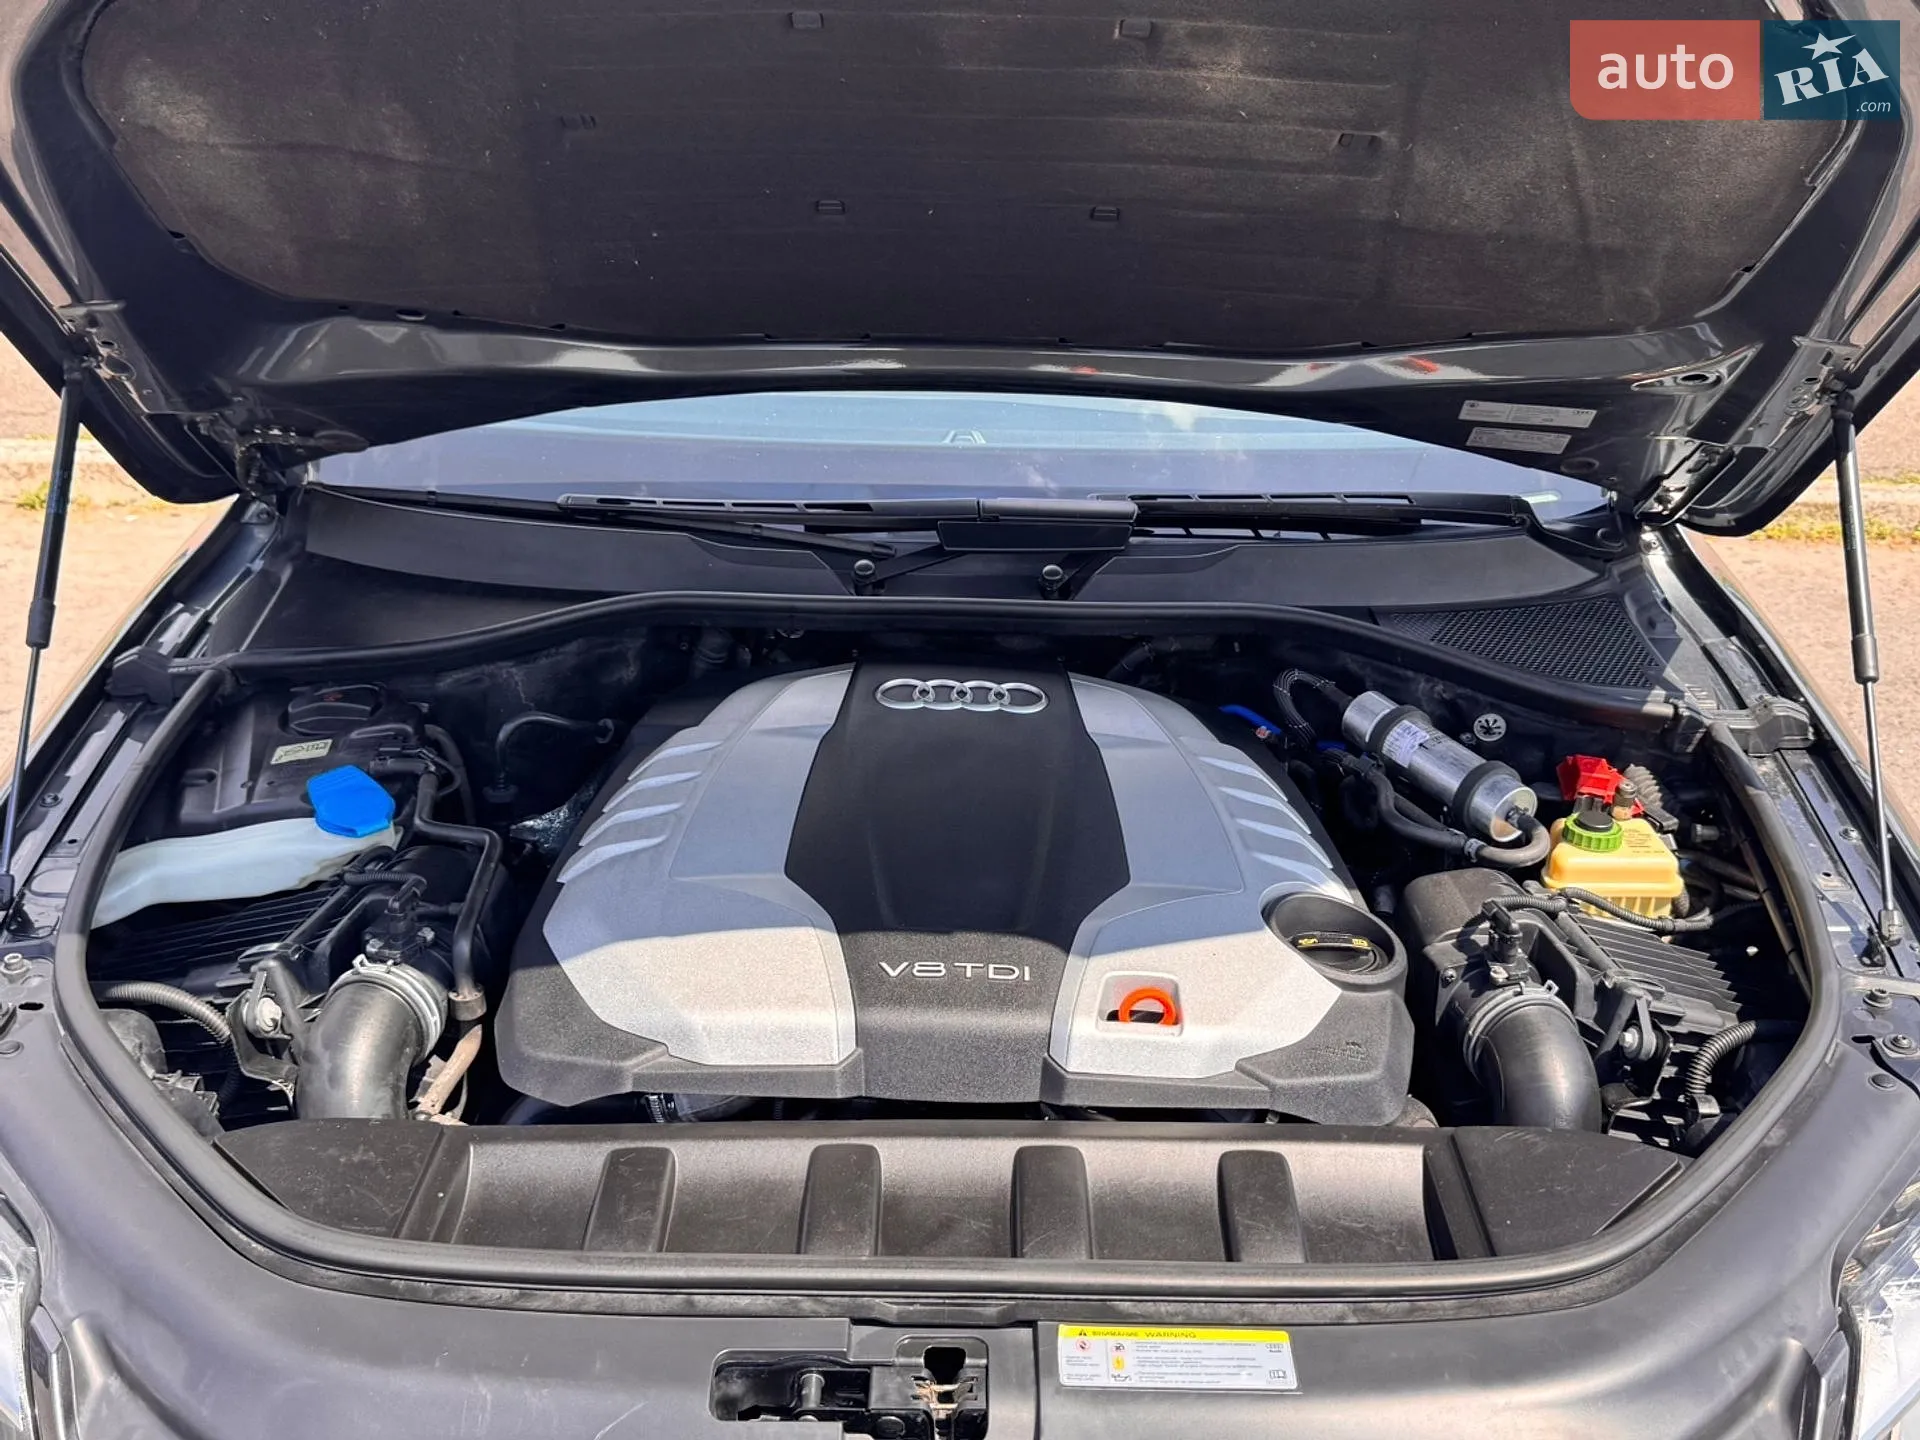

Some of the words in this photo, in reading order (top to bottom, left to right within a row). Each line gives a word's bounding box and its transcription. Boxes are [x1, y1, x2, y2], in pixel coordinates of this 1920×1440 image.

[878, 961, 947, 978] V8
[953, 962, 1032, 982] TDI
[1145, 1331, 1197, 1339] WARNING
